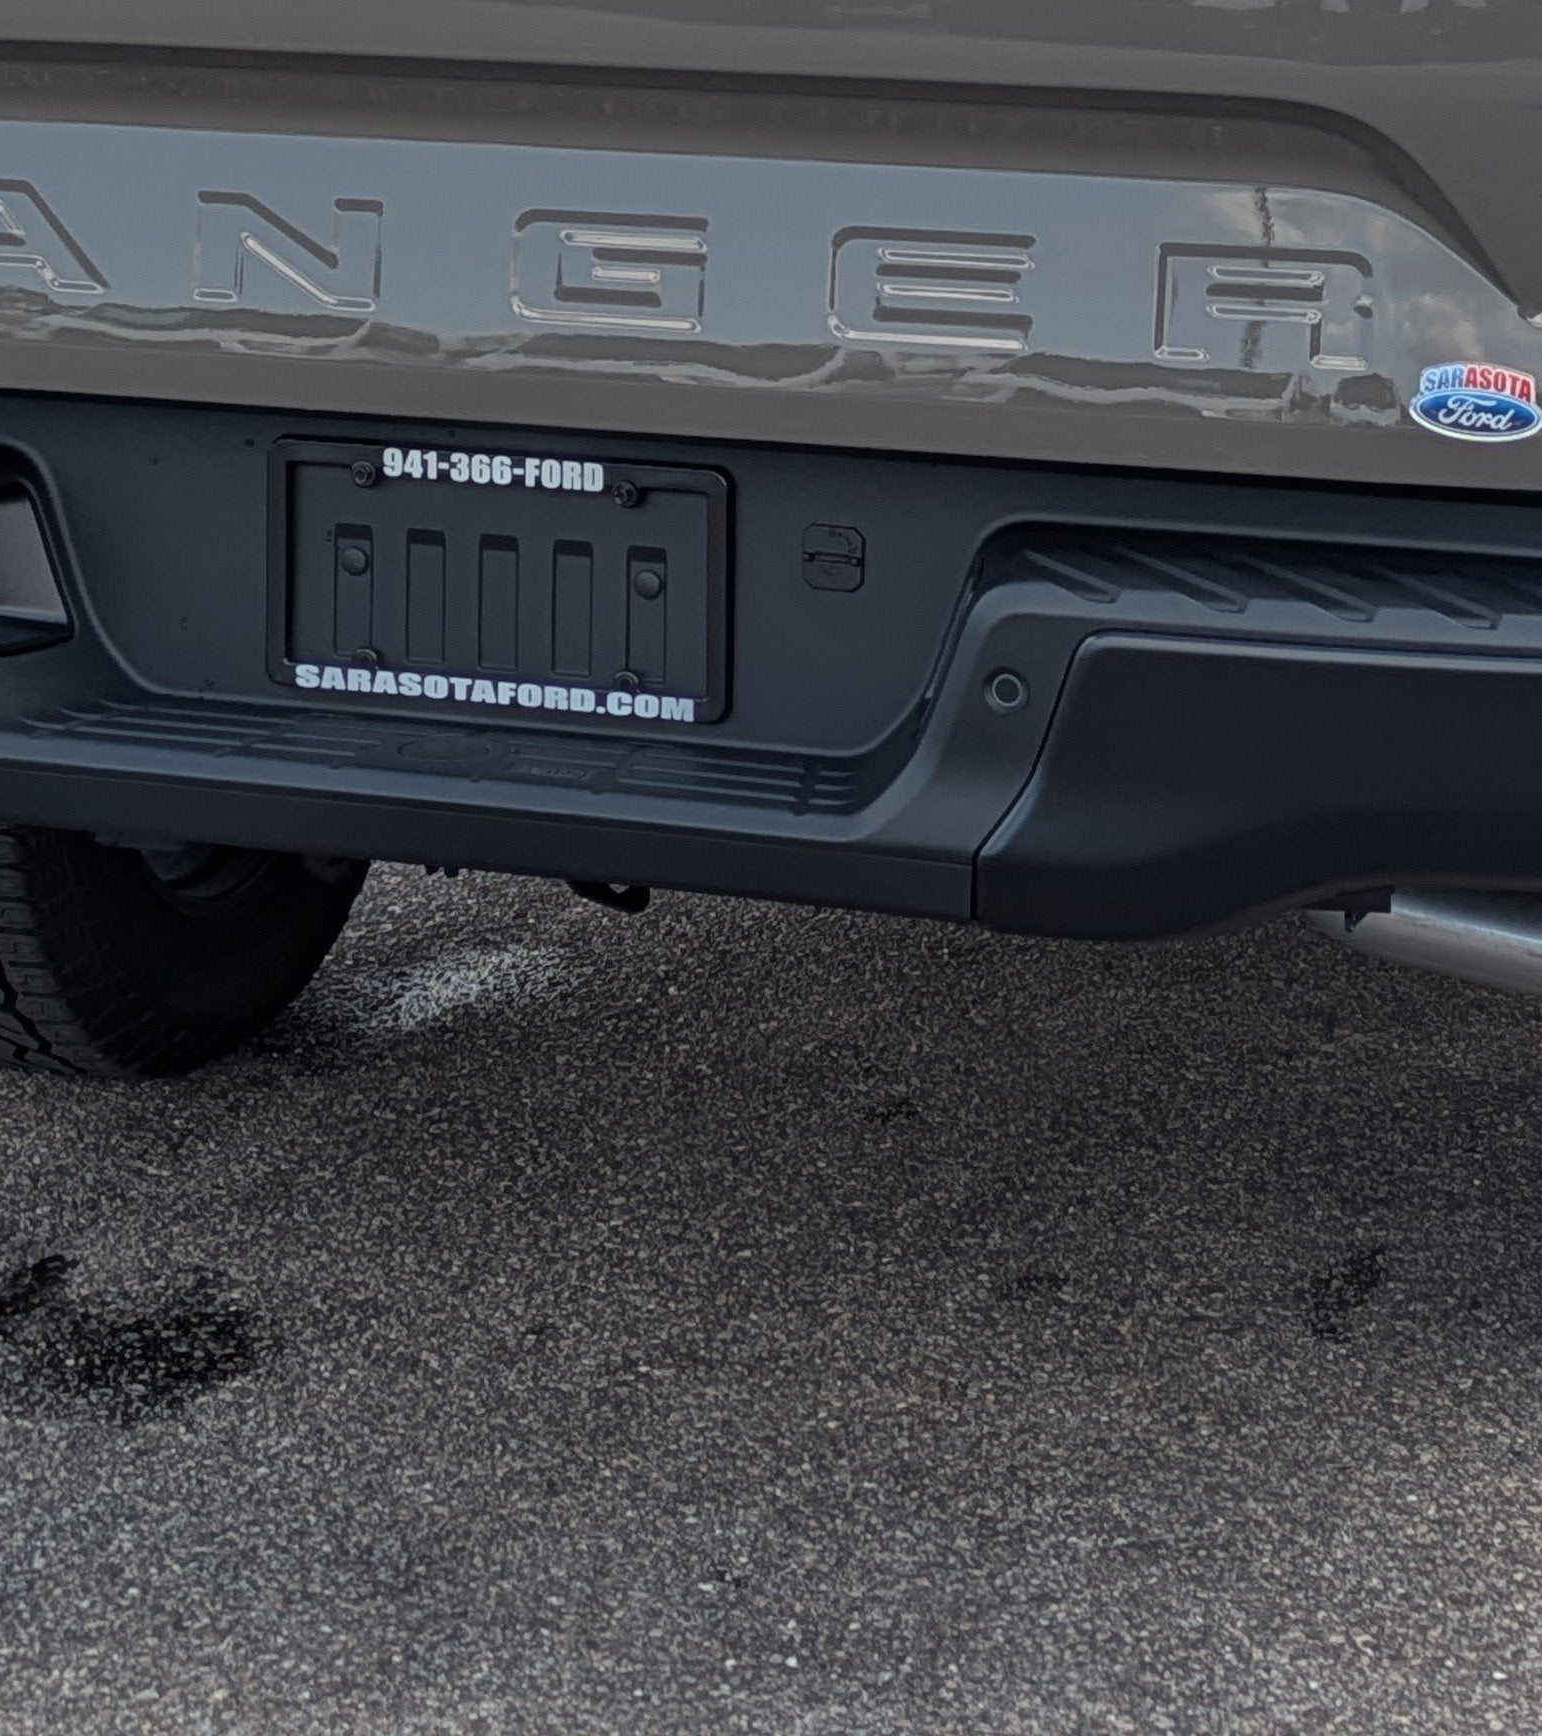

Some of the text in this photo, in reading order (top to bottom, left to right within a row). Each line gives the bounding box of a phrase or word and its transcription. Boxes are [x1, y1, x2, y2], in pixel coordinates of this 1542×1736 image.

[1424, 366, 1532, 403] SARASOTA
[1437, 395, 1514, 431] Ford
[382, 446, 605, 493] 941-366-FORD
[294, 663, 696, 723] SARASOTAFORD.COM
